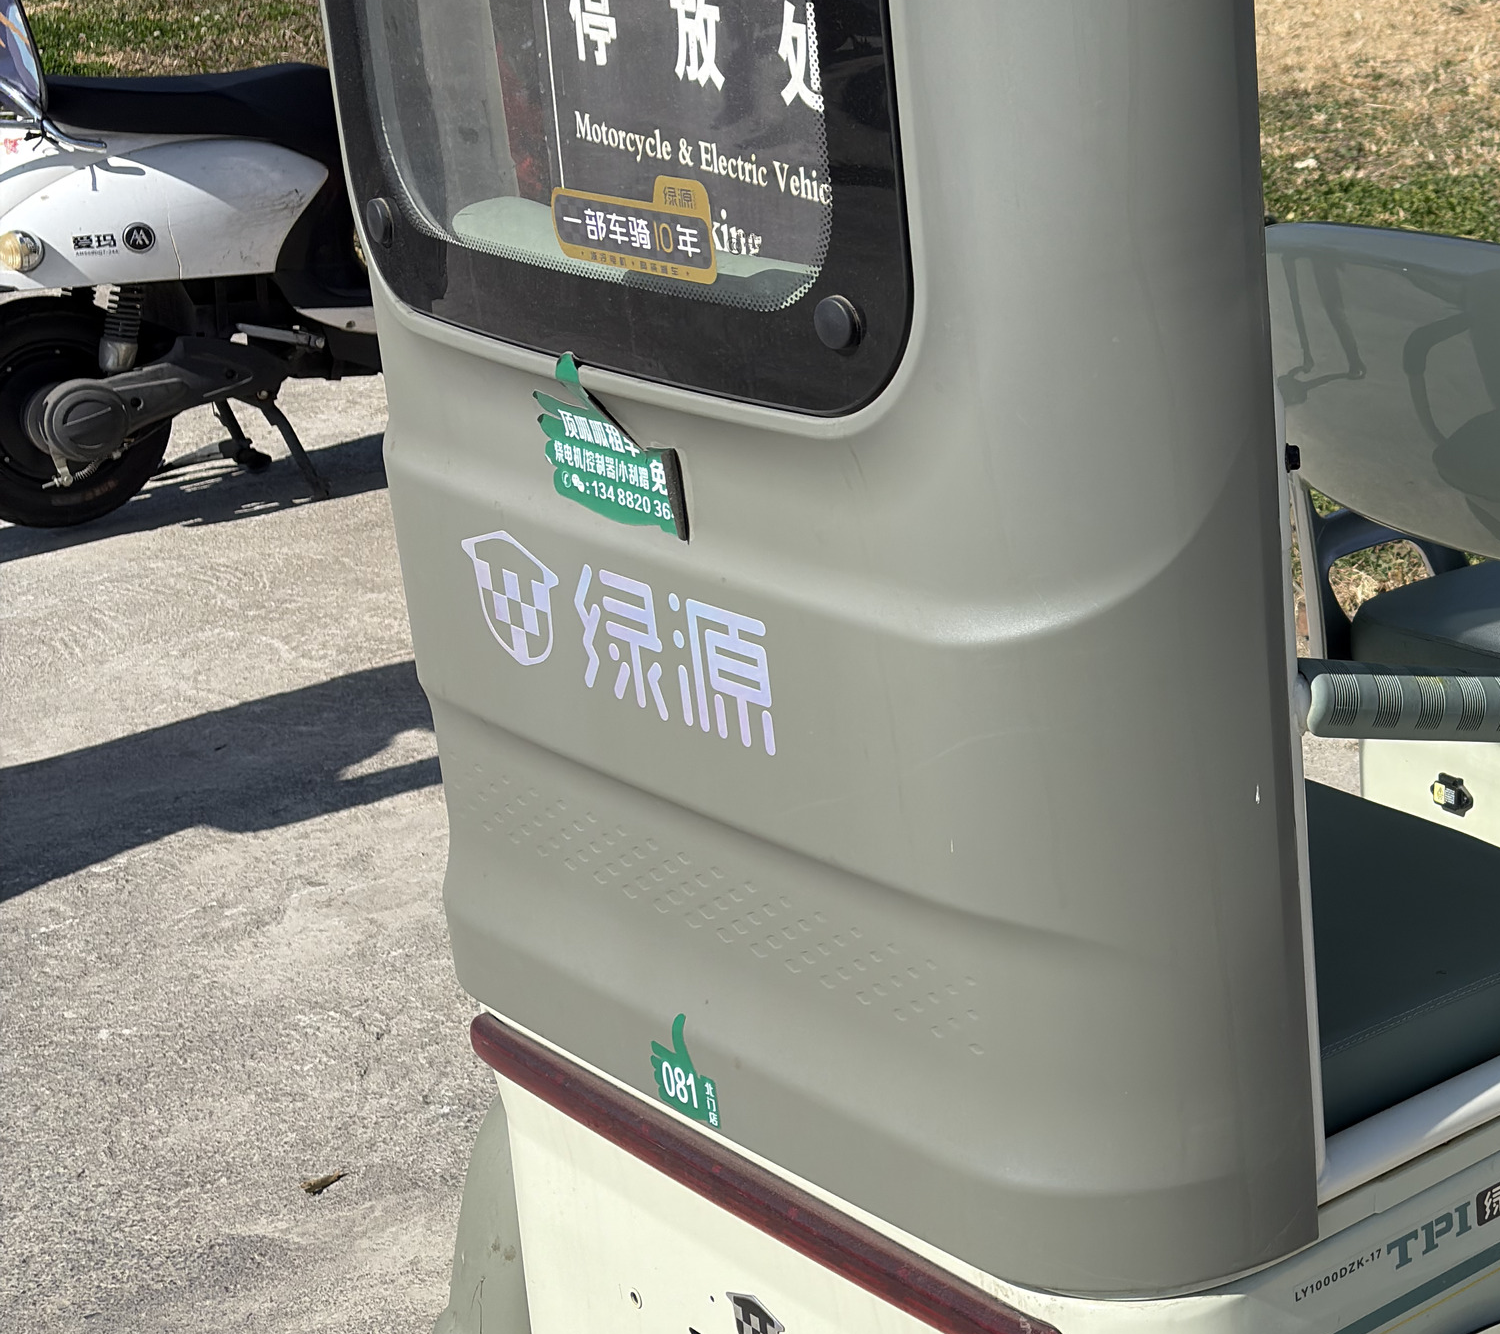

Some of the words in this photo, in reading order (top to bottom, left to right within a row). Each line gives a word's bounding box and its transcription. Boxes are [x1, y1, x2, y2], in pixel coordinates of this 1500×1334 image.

[574, 111, 672, 162] Motorcycle
[677, 138, 694, 167] &
[699, 140, 768, 187] Electric
[663, 186, 695, 209] 绿源
[72, 233, 117, 250] 爱玛
[563, 208, 701, 257] 一部车骑10年
[617, 485, 651, 513] 8820
[653, 500, 675, 520] 36
[574, 564, 776, 756] 绿源
[662, 1061, 698, 1109] 081
[1295, 1248, 1383, 1302] LY1000DZK-17
[1387, 1201, 1472, 1271] TPI
